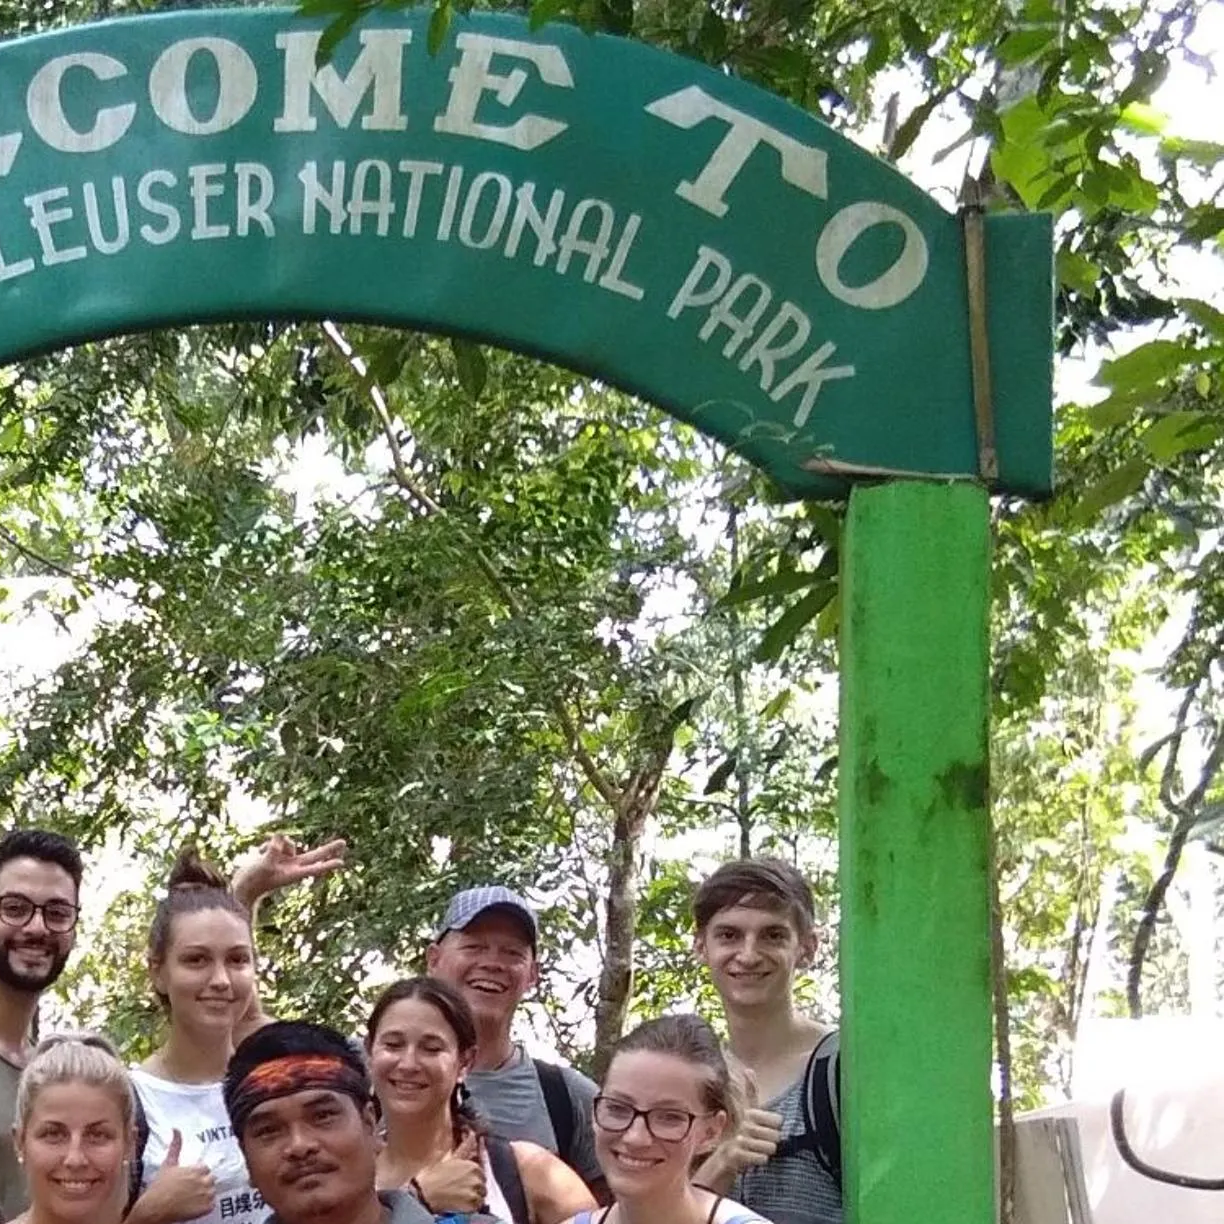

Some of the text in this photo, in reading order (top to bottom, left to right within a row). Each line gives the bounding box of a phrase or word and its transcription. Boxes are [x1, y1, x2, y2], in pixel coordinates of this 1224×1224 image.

[298, 159, 645, 300] NATIONAL
[666, 245, 856, 428] PARK
[644, 85, 929, 310] TO
